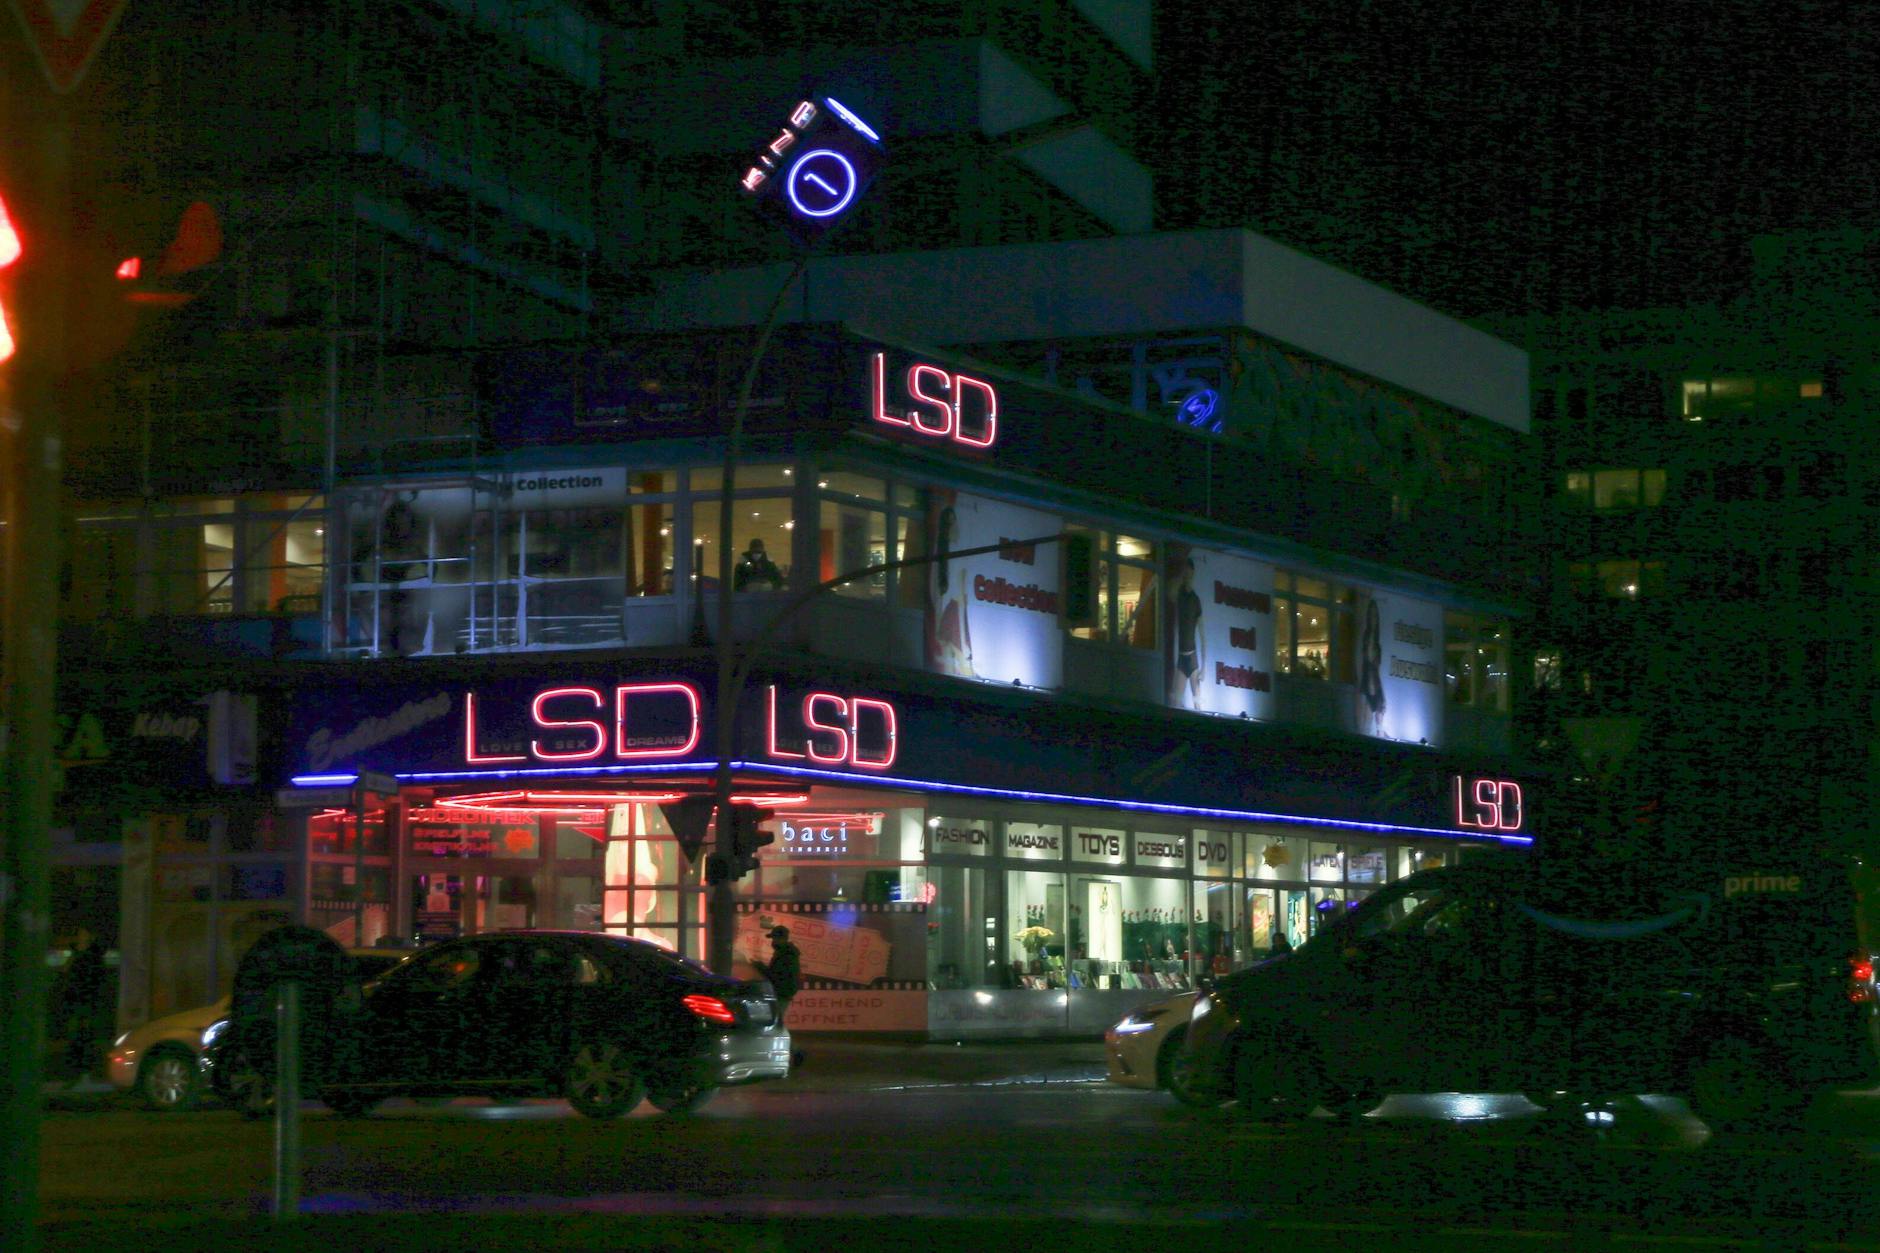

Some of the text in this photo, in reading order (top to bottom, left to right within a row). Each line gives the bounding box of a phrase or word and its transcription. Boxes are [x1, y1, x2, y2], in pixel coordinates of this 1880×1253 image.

[872, 352, 997, 448] LSD
[466, 684, 700, 763] LSD
[766, 684, 897, 768] LSD
[481, 735, 686, 753] LOVE SEX DREAMS
[1456, 775, 1523, 831] LSD
[782, 821, 847, 842] baci
[936, 828, 990, 845] FASHION
[1008, 834, 1059, 850] MAGAZINE
[1078, 833, 1120, 856] TOYS
[1137, 842, 1184, 859] DESSOUS
[1198, 842, 1227, 862] DVD
[1724, 870, 1801, 898] prime
